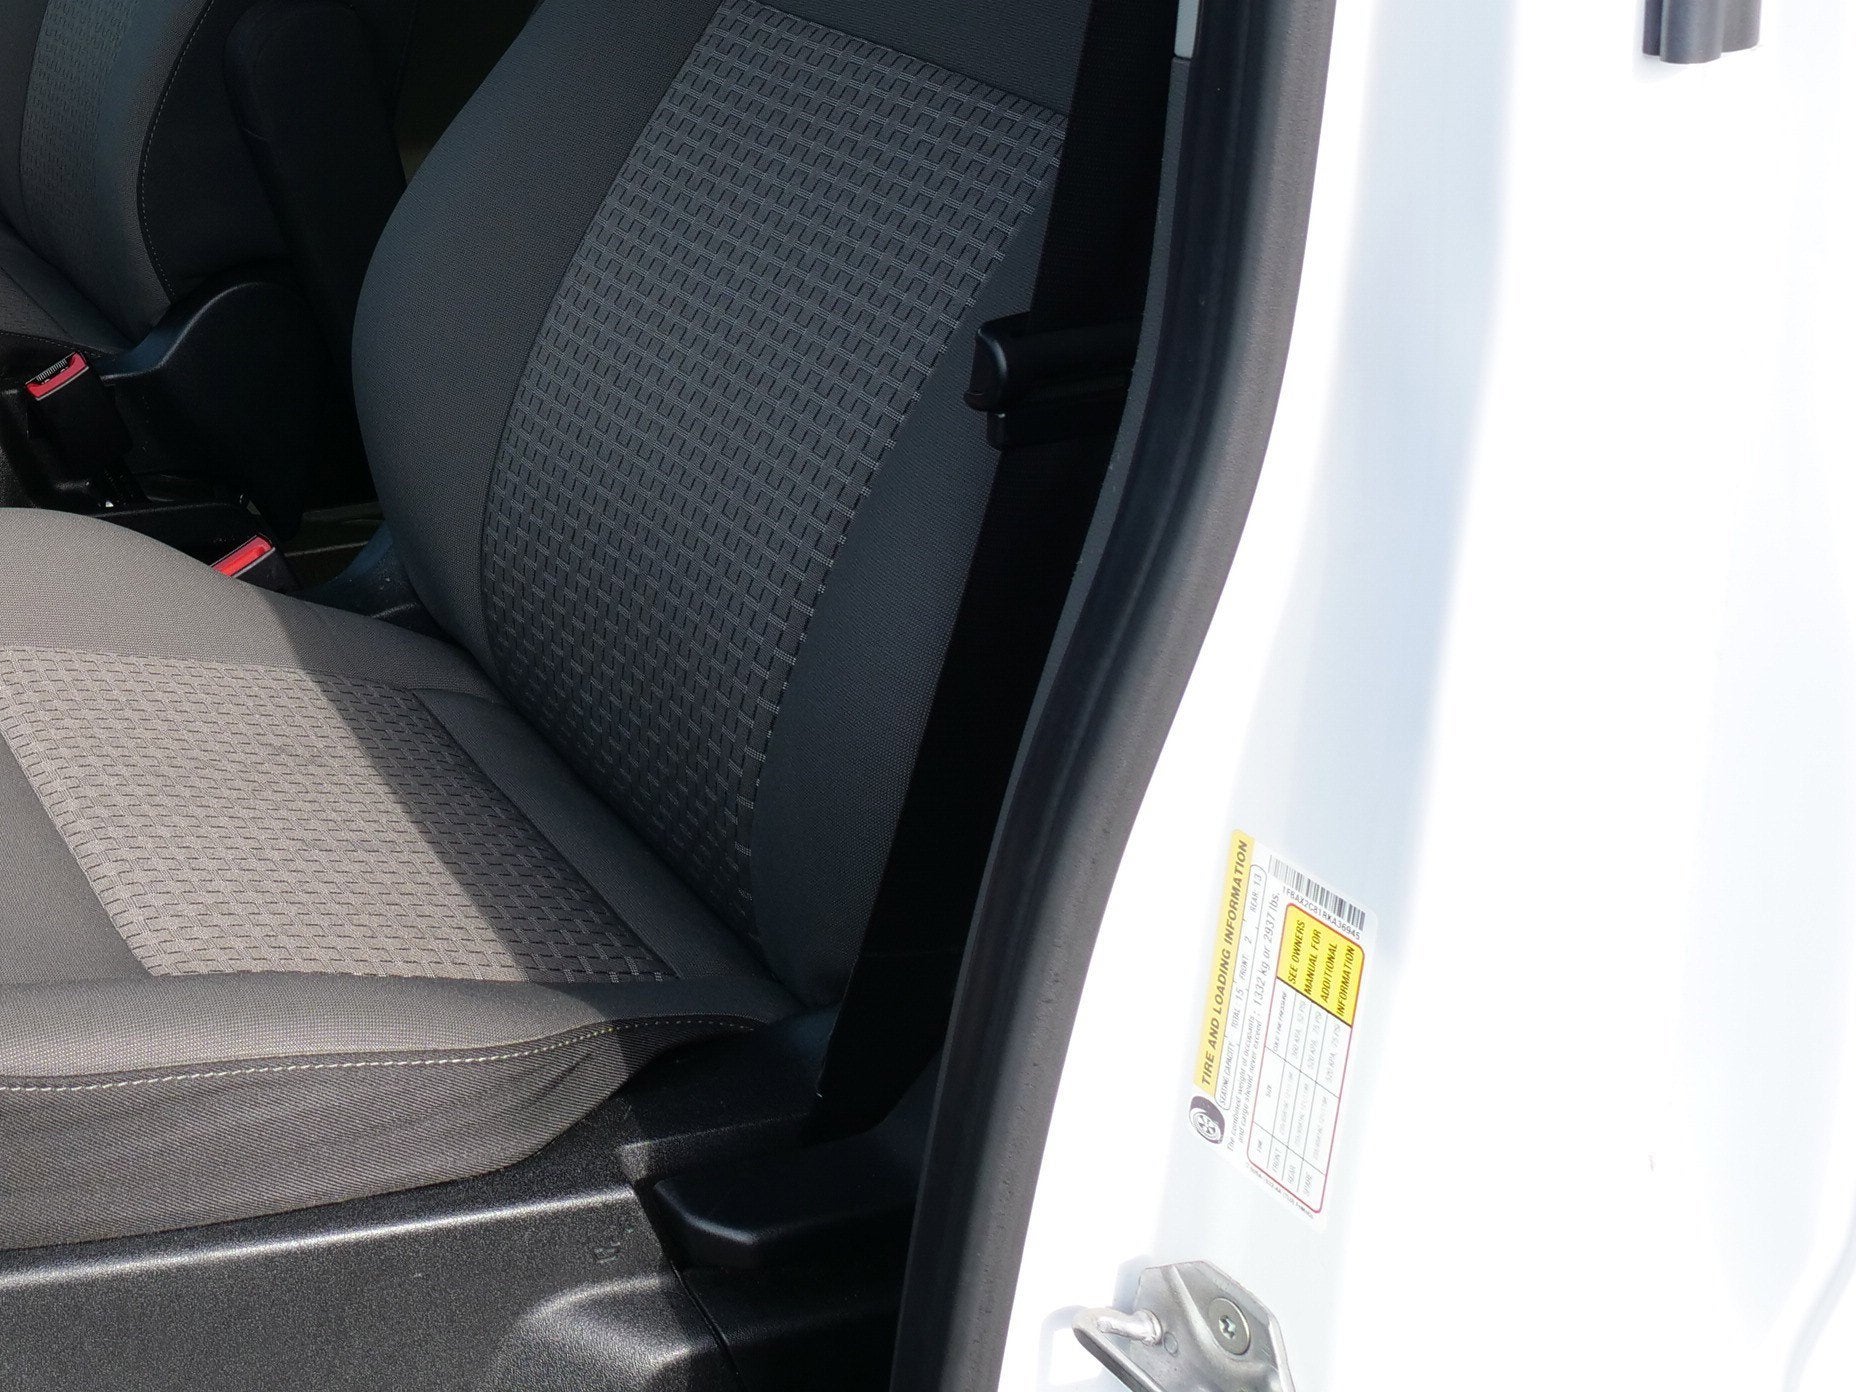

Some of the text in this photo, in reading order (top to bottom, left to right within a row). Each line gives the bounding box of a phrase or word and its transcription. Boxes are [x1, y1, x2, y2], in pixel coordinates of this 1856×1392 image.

[1235, 986, 1244, 1002] 15
[1243, 934, 1251, 944] 2
[1253, 872, 1261, 887] 13
[1262, 945, 1270, 959] or
[1263, 911, 1275, 943] 2937
[1287, 918, 1305, 985] SEE OWNERS
[1201, 839, 1247, 1088] TIRE AND LOADING INFORMATION
[1252, 975, 1265, 1007] 1332
[1257, 958, 1270, 977] kg
[1303, 927, 1321, 995] MANUAL FOR
[1320, 939, 1337, 1003] ADDITIONAL
[1335, 943, 1355, 1017] INFORMATION
